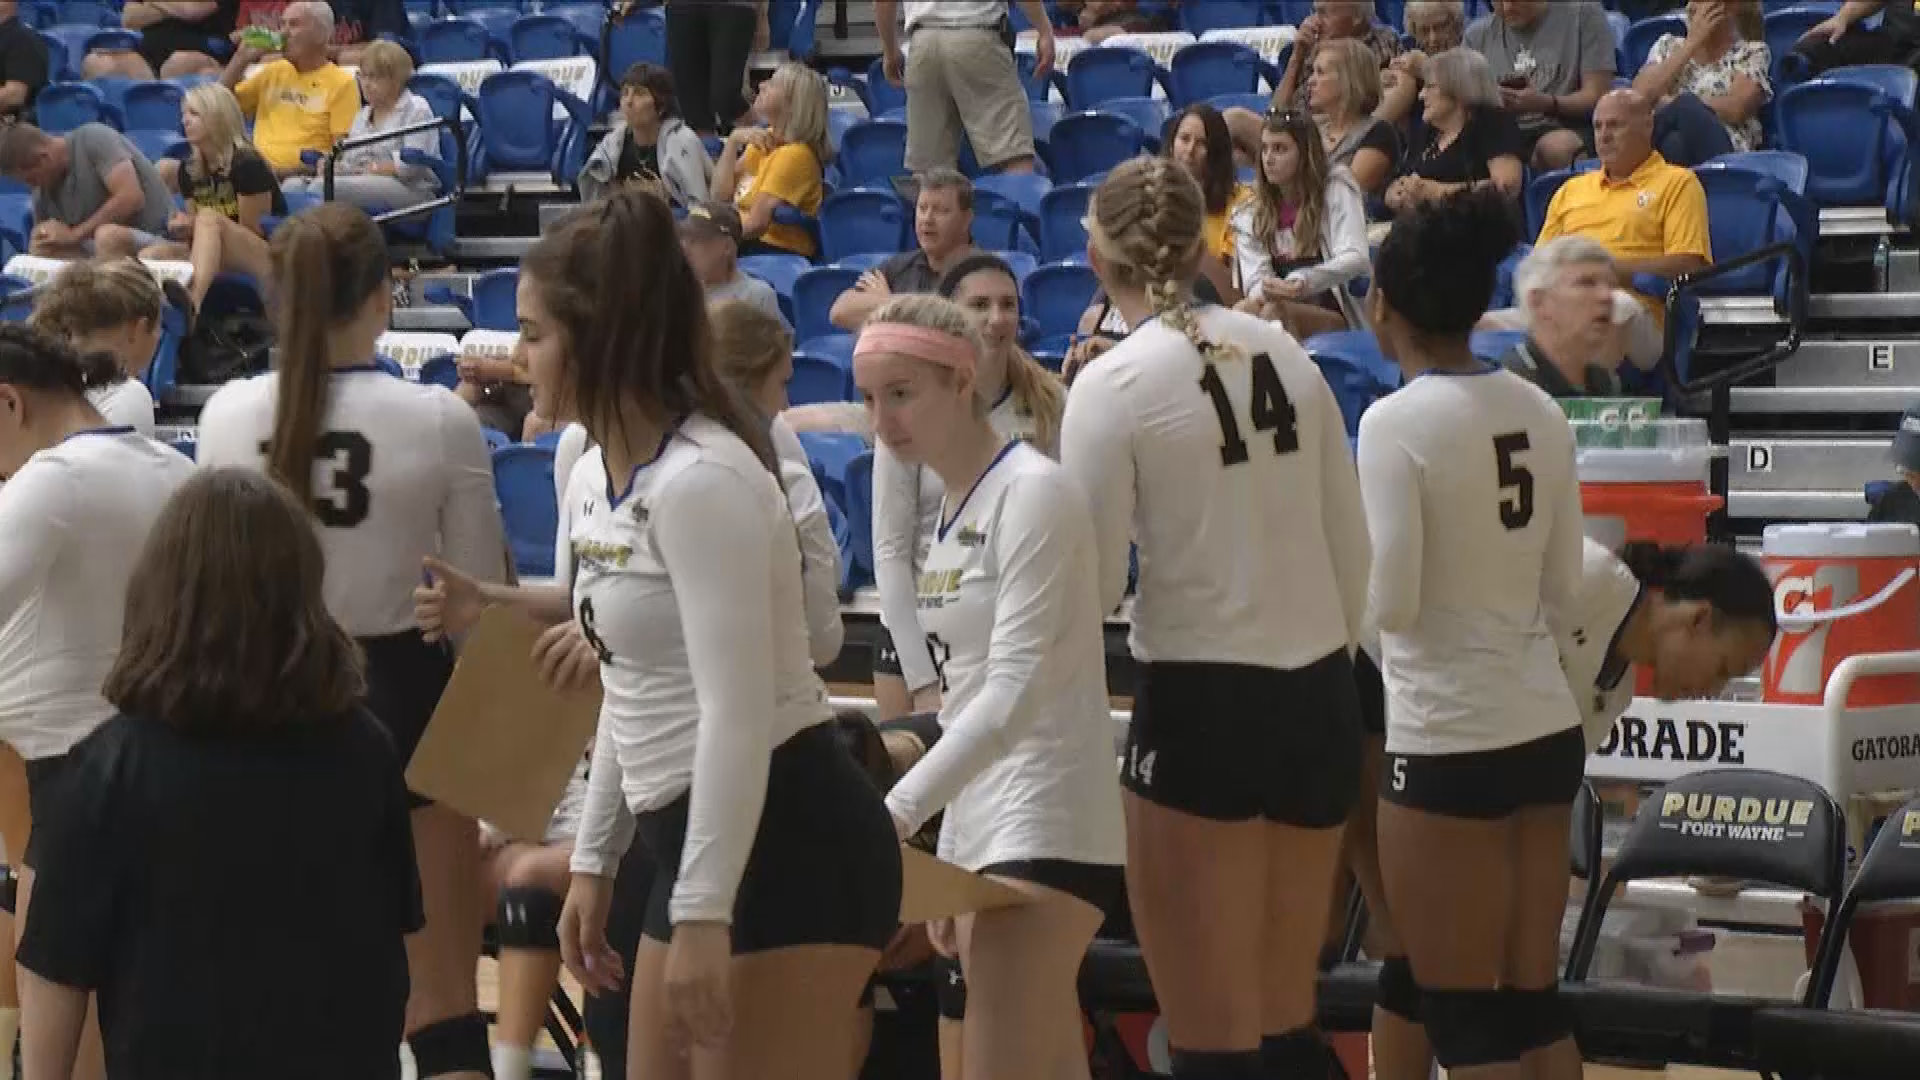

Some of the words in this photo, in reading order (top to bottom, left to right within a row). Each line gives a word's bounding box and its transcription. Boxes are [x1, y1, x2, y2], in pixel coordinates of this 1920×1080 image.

[1872, 345, 1890, 369] E
[1199, 351, 1299, 467] 14
[1750, 447, 1769, 470] D
[1492, 431, 1534, 529] 5
[1129, 744, 1157, 785] 14
[1392, 757, 1408, 791] 5
[1661, 791, 1815, 825] PURDUE
[1680, 820, 1727, 837] FORT
[1727, 825, 1785, 841] WAYNE
